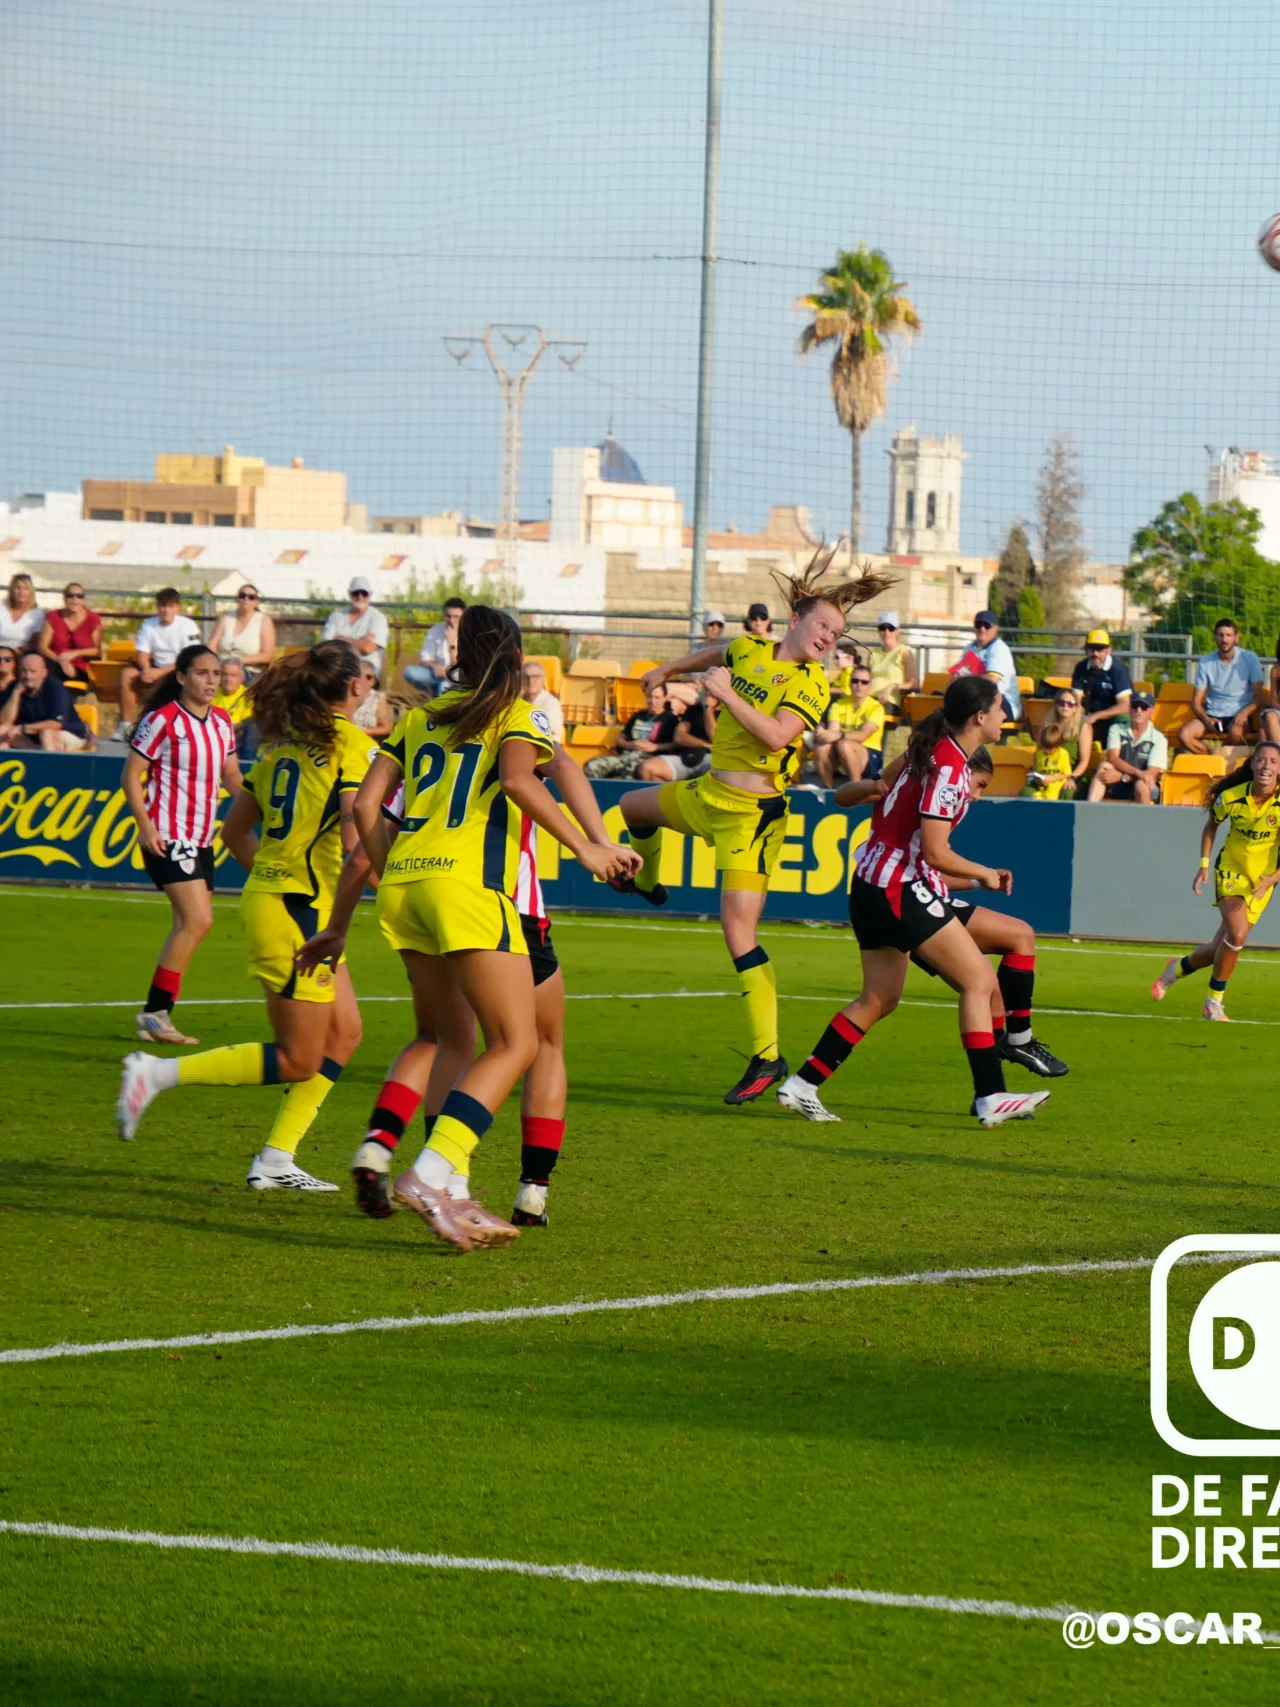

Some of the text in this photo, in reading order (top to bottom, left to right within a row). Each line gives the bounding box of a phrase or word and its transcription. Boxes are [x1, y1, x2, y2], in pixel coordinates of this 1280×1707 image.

[731, 674, 769, 704] MESA
[266, 756, 301, 841] 9
[398, 741, 485, 834] 21
